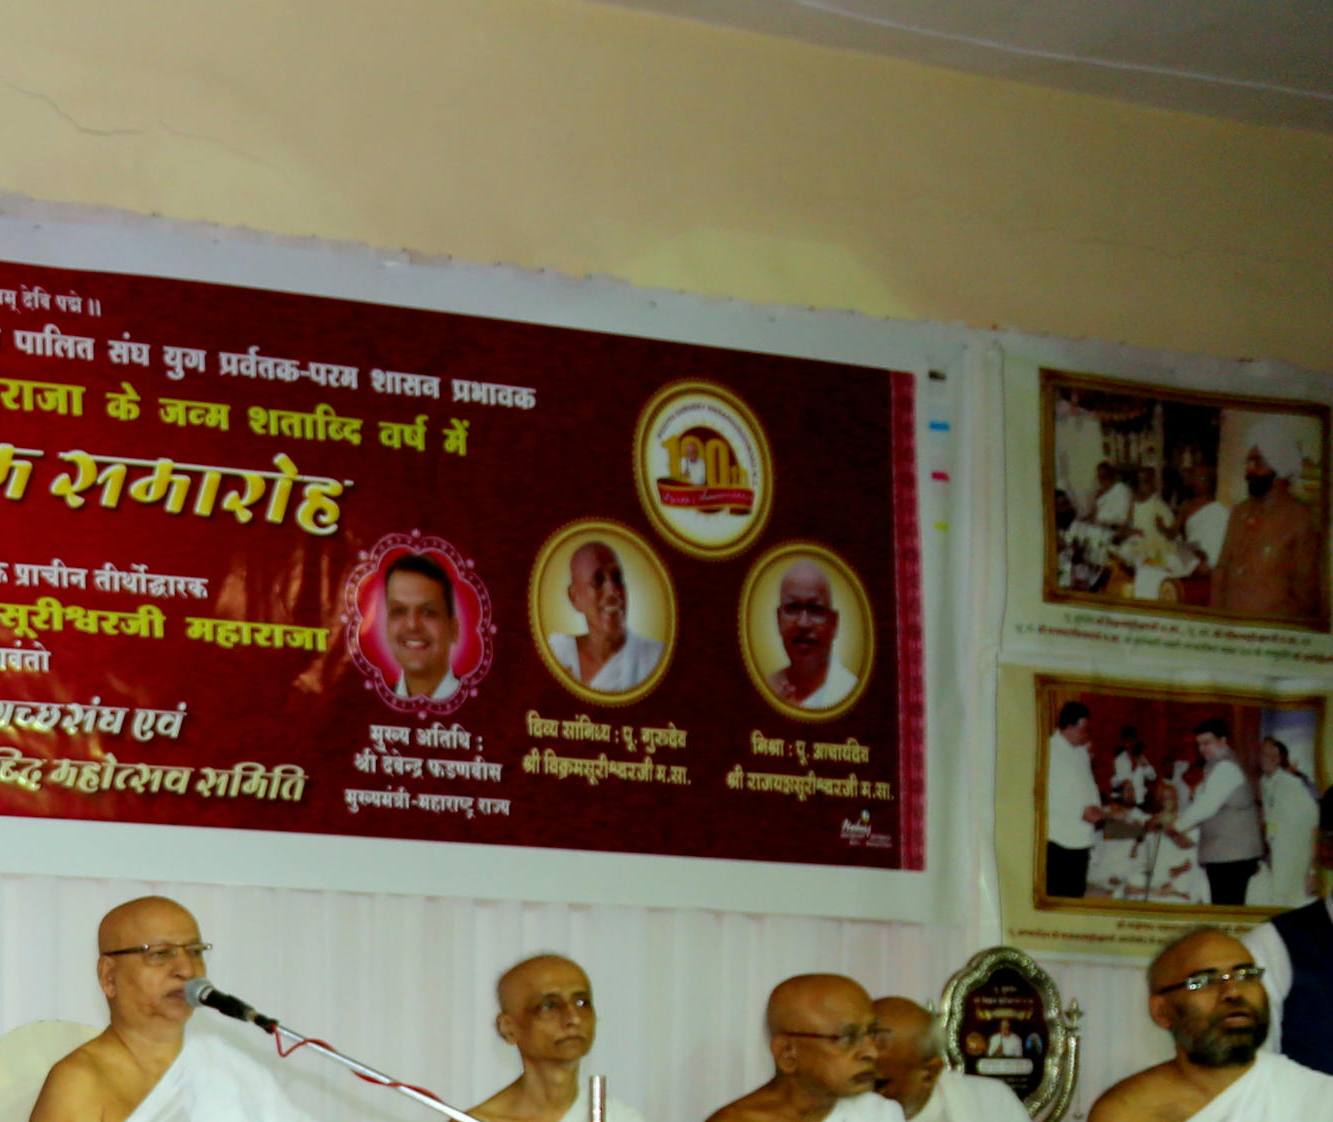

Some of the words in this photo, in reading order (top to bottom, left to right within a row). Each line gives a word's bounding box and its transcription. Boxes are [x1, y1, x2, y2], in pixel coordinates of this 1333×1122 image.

[15, 324, 95, 362] पालित
[108, 332, 150, 367] संघ
[163, 346, 206, 380] युग
[371, 368, 440, 399] शासन
[452, 378, 537, 409] प्रभावक
[106, 382, 140, 422] के
[159, 396, 230, 431] जन्म
[249, 403, 362, 446] शताब्दि
[379, 415, 429, 454] वर्ष
[443, 419, 470, 456] में
[49, 450, 355, 536] समारोह
[14, 559, 89, 590] प्राचीन
[186, 615, 330, 653] महाराजा
[133, 702, 188, 741] एवं
[370, 724, 411, 753] मुख्य
[416, 722, 472, 750] अतिथि
[526, 710, 559, 738] दिव्य
[621, 725, 638, 752] पू.
[354, 748, 378, 773] श्री
[522, 747, 541, 773] श्री
[655, 764, 692, 785] म.सा.
[795, 740, 811, 766] पू.
[50, 756, 193, 796] महोत्सव
[197, 761, 311, 803] समिति
[726, 764, 744, 789] श्री
[861, 781, 895, 800] म.सा.
[476, 798, 511, 816] राज्य
